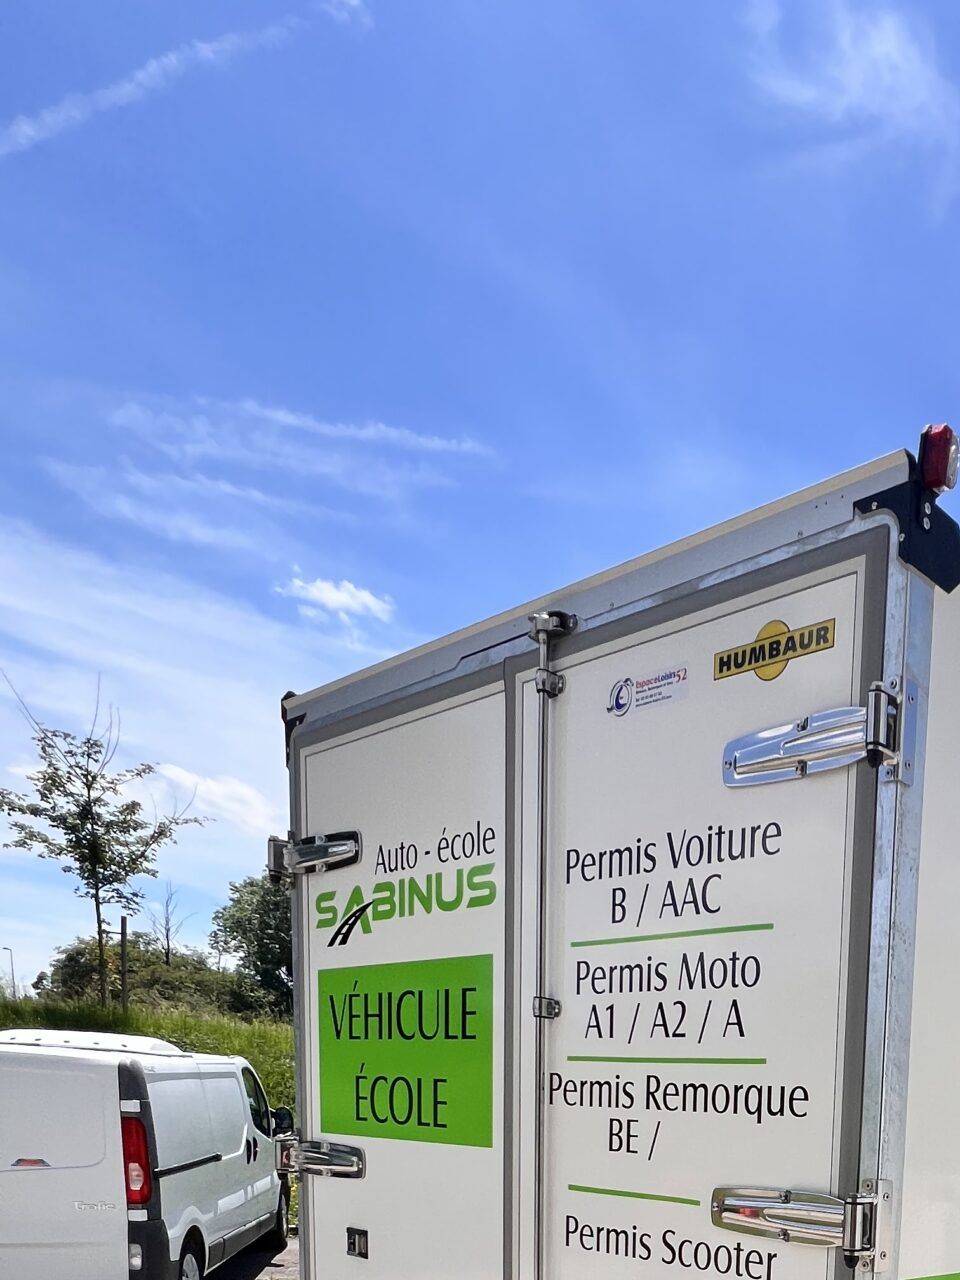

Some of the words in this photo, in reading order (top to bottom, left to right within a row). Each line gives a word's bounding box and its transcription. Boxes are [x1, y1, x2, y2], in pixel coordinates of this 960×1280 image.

[718, 625, 830, 674] HUMBAUR
[375, 841, 419, 875] Auto
[437, 820, 497, 863] école
[566, 838, 657, 885] Permis
[667, 820, 783, 866] Voiture
[315, 862, 498, 935] SABINUS
[610, 887, 627, 924] B
[636, 882, 650, 928] /
[659, 874, 723, 919] AAC
[575, 957, 667, 996] Permis
[677, 950, 762, 992] Moto
[328, 980, 478, 1041] VÉHICULE
[584, 1004, 617, 1040] A1
[627, 1002, 641, 1046] /
[650, 1001, 687, 1038] A2
[697, 999, 711, 1045] /
[722, 1001, 746, 1038] A
[354, 1063, 448, 1129] ÉCOLE
[548, 1072, 635, 1111] Permis
[644, 1074, 810, 1124] Remorque
[607, 1118, 639, 1154] BE
[647, 1121, 661, 1160] /
[564, 1215, 652, 1262] Permis
